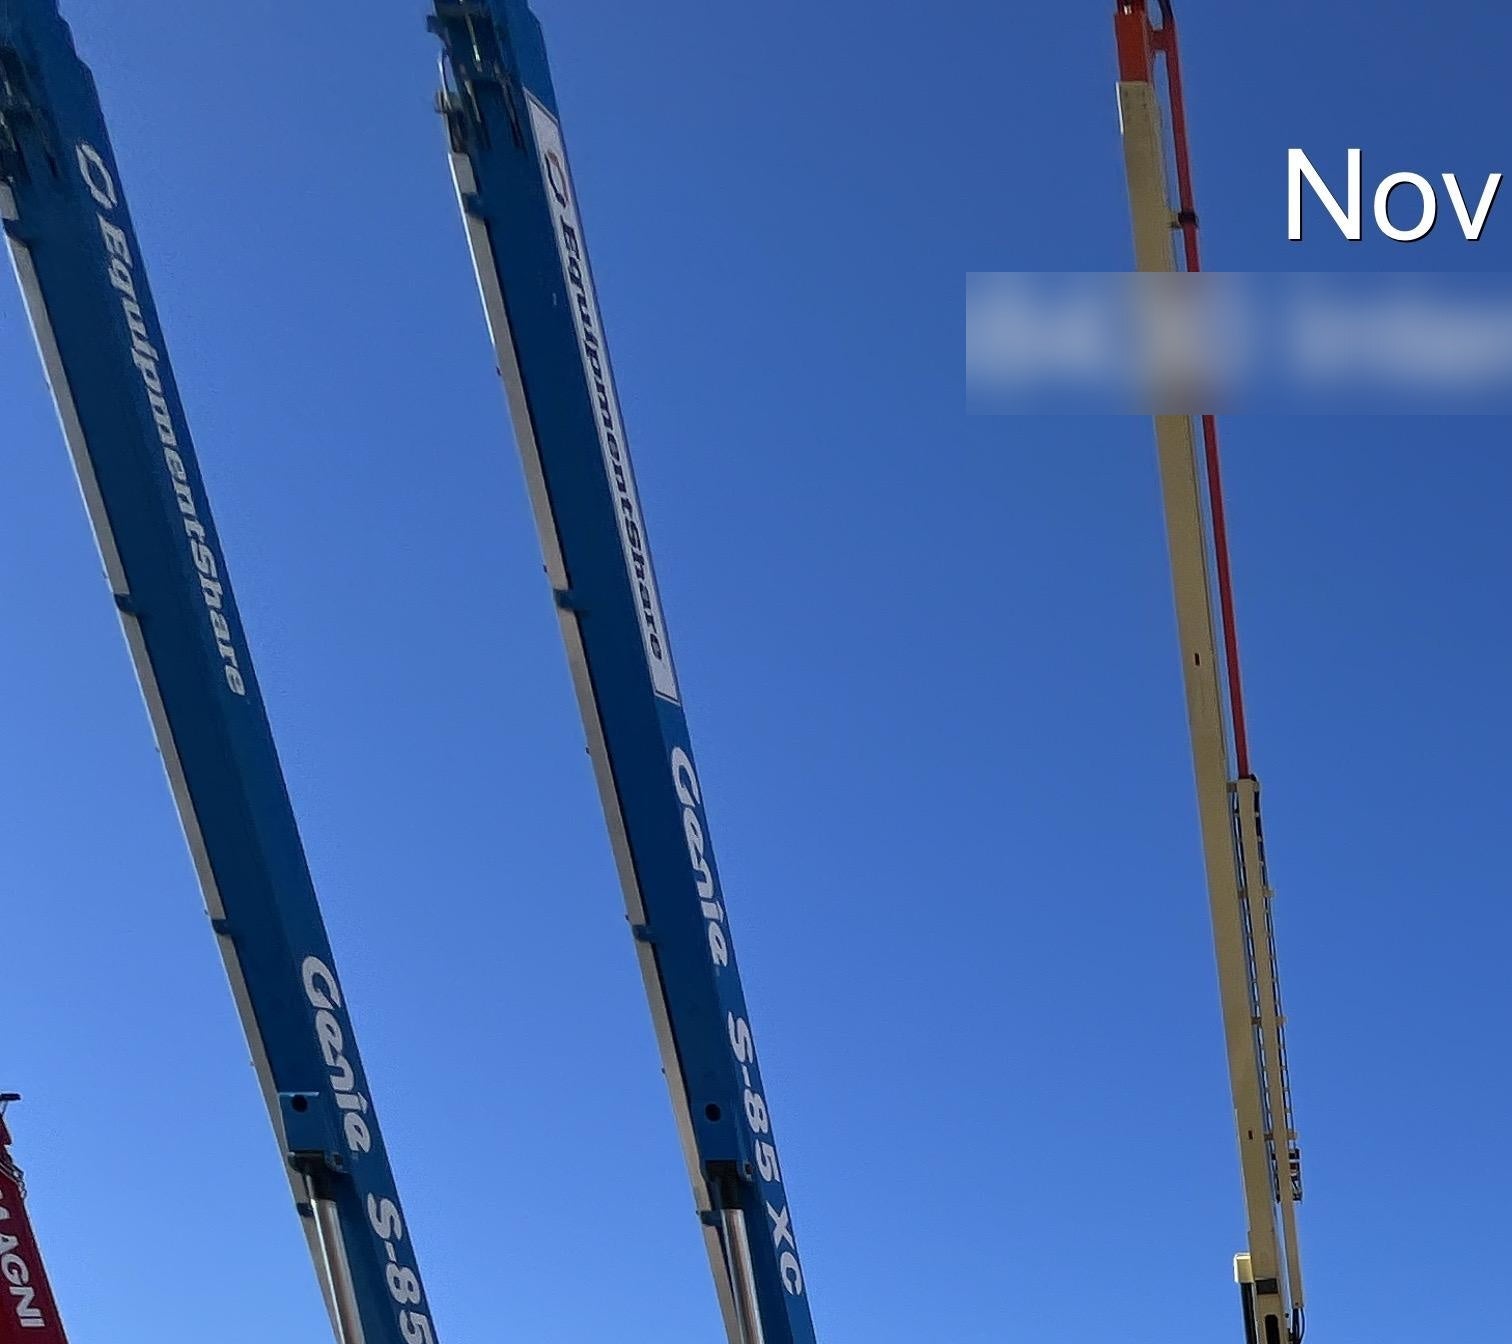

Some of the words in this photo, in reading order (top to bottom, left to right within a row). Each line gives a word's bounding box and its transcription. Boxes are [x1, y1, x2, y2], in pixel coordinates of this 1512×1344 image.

[98, 215, 247, 698] EquipmentShare
[558, 218, 665, 660] EquipmentShare
[302, 956, 370, 1154] Genie
[670, 745, 729, 967] Genie
[726, 1010, 780, 1183] S-85
[766, 1201, 802, 1297] XC
